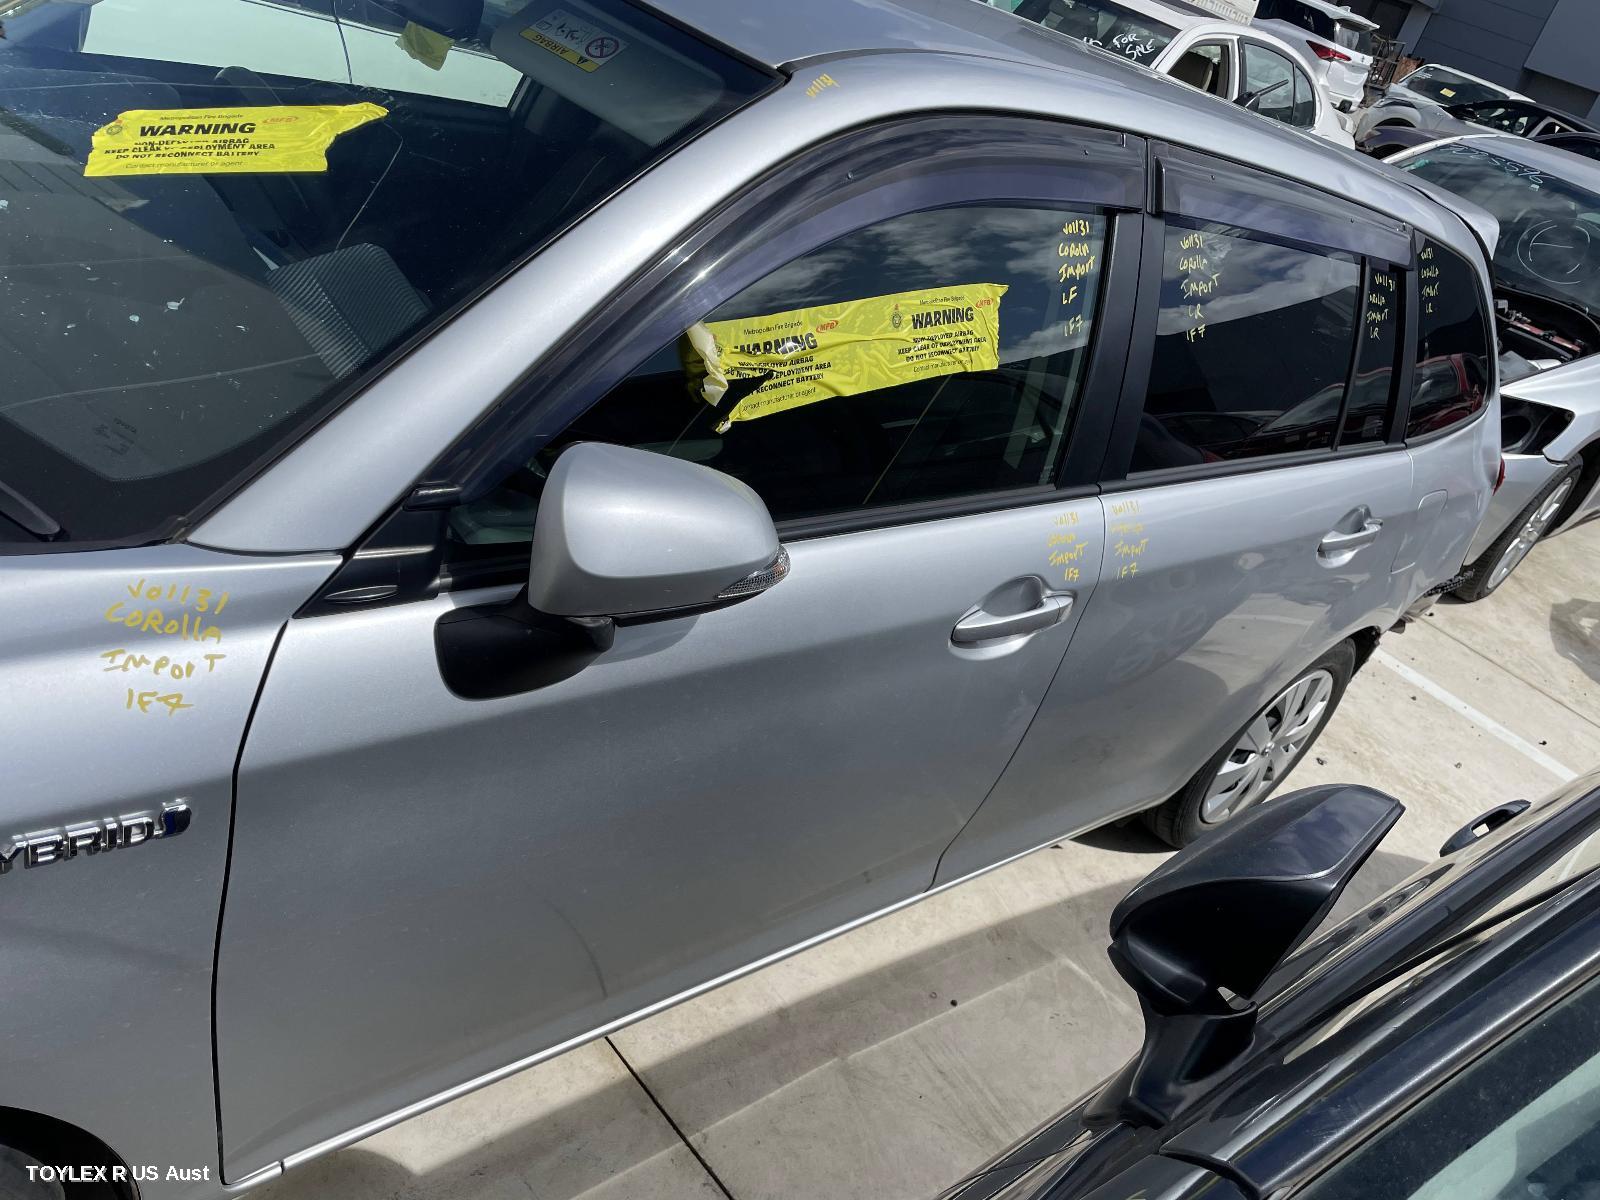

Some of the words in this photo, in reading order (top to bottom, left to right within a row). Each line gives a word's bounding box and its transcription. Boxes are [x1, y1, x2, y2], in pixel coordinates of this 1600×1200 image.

[532, 34, 568, 55] AIRBAG
[1112, 32, 1140, 49] FOR
[139, 122, 256, 137] WARNING
[911, 306, 974, 330] WARNING
[954, 329, 974, 337] AIRBAG
[898, 347, 912, 356] KEEP
[788, 355, 814, 366] AIRBAG
[771, 365, 814, 381] EPLOYMENT
[814, 361, 832, 372] AREA
[795, 372, 824, 384] BATTERY
